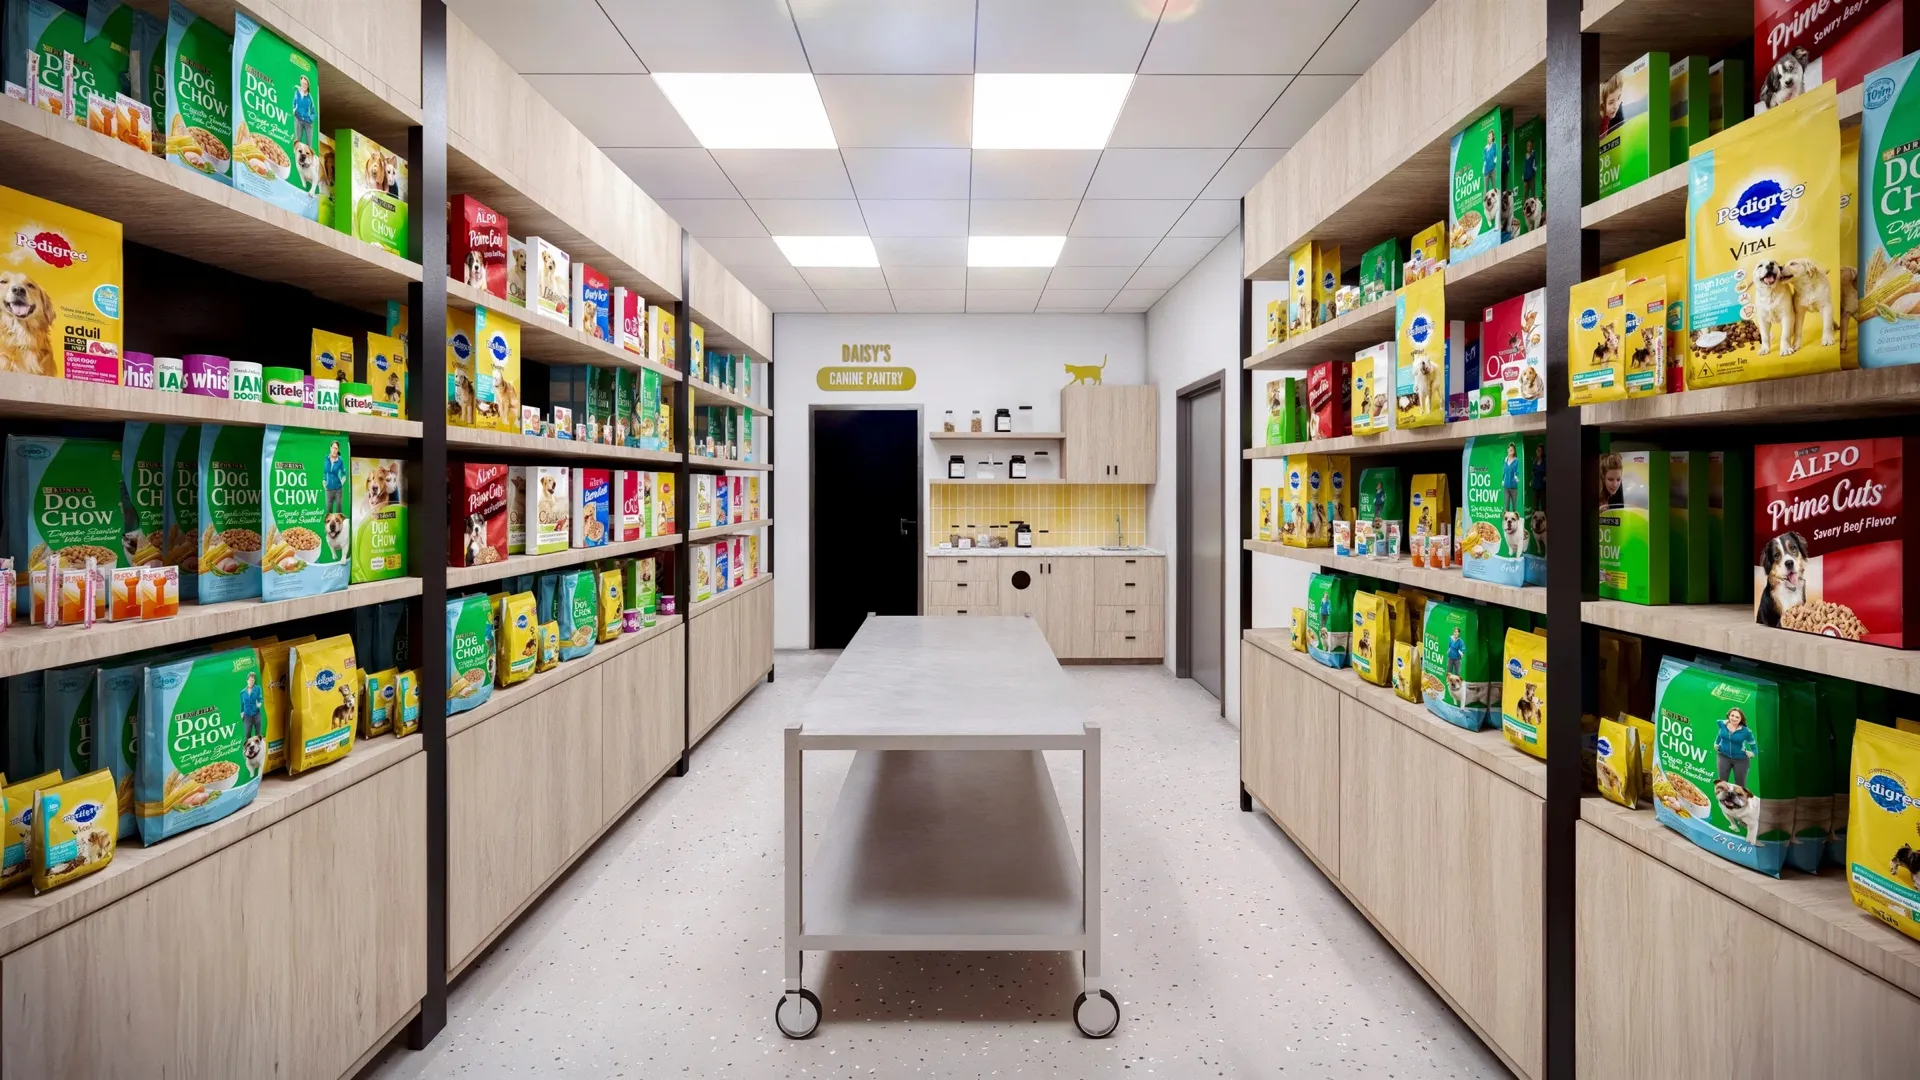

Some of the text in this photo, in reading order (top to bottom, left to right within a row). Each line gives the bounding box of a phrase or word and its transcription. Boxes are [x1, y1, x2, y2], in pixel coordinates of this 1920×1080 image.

[180, 61, 216, 95] DOG
[245, 71, 278, 104] DOG
[178, 80, 229, 118] CHOW
[244, 89, 290, 126] CHOW
[1716, 183, 1806, 226] Pedigree
[15, 231, 88, 263] Pedigree
[1729, 236, 1776, 261] VITAL
[841, 343, 892, 363] DAISY'S
[829, 371, 904, 386] CANINE PANTRY
[1787, 445, 1860, 483] ALPO
[213, 468, 249, 487] DOG
[275, 469, 308, 487] DOG
[1470, 472, 1491, 487] DOG
[44, 493, 97, 511] DOG
[211, 487, 263, 506] CHOW
[273, 487, 319, 506] CHOW
[1469, 488, 1499, 503] CHOW
[1767, 478, 1883, 532] Prime Cuts
[41, 510, 114, 527] CHOW
[371, 534, 397, 548] CHOW
[173, 722, 237, 752] CHOW
[175, 712, 221, 738] DOG
[1661, 715, 1693, 742] DOG
[1660, 732, 1708, 764] CHOW
